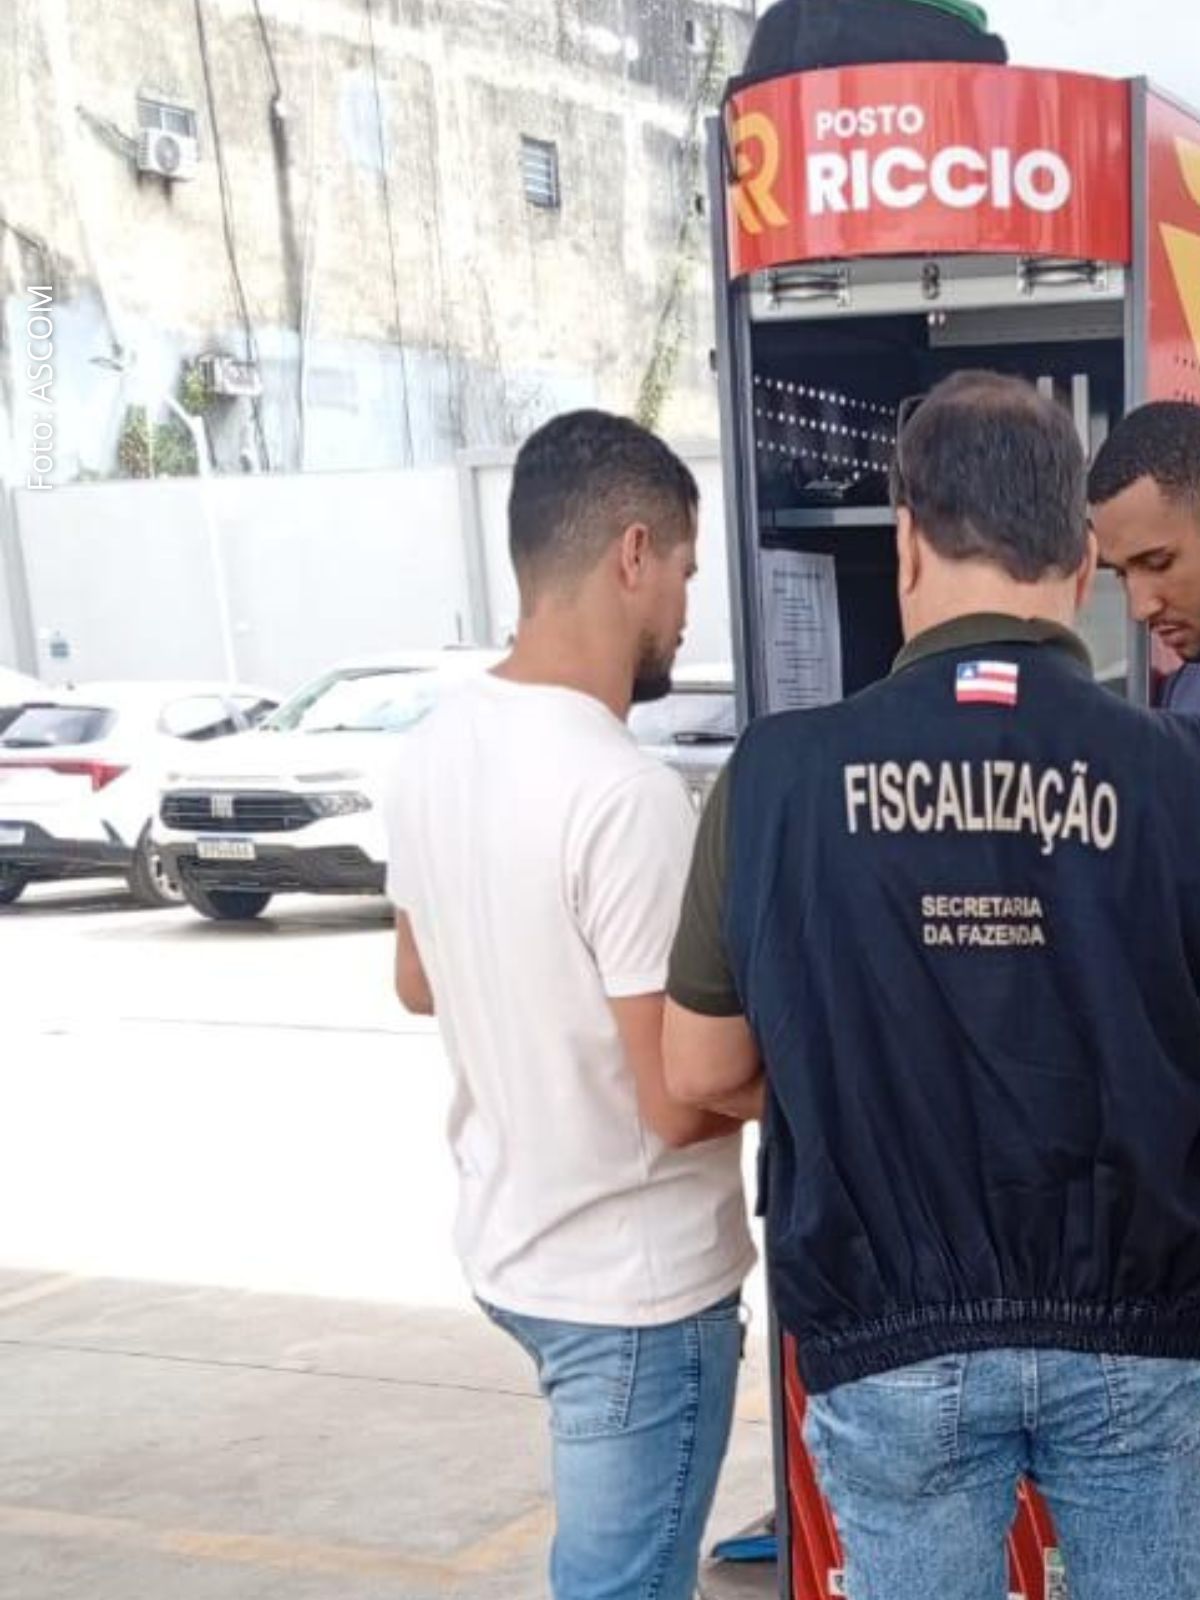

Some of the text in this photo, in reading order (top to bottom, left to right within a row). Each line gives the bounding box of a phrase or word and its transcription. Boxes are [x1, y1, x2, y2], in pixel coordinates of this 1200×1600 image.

[816, 104, 925, 140] POSTO
[806, 146, 1071, 215] RICCIO
[844, 760, 1118, 856] FISCALIZAÇÃO
[921, 895, 1043, 918] SECRETARIA
[923, 925, 1045, 946] DA FAZENDA
